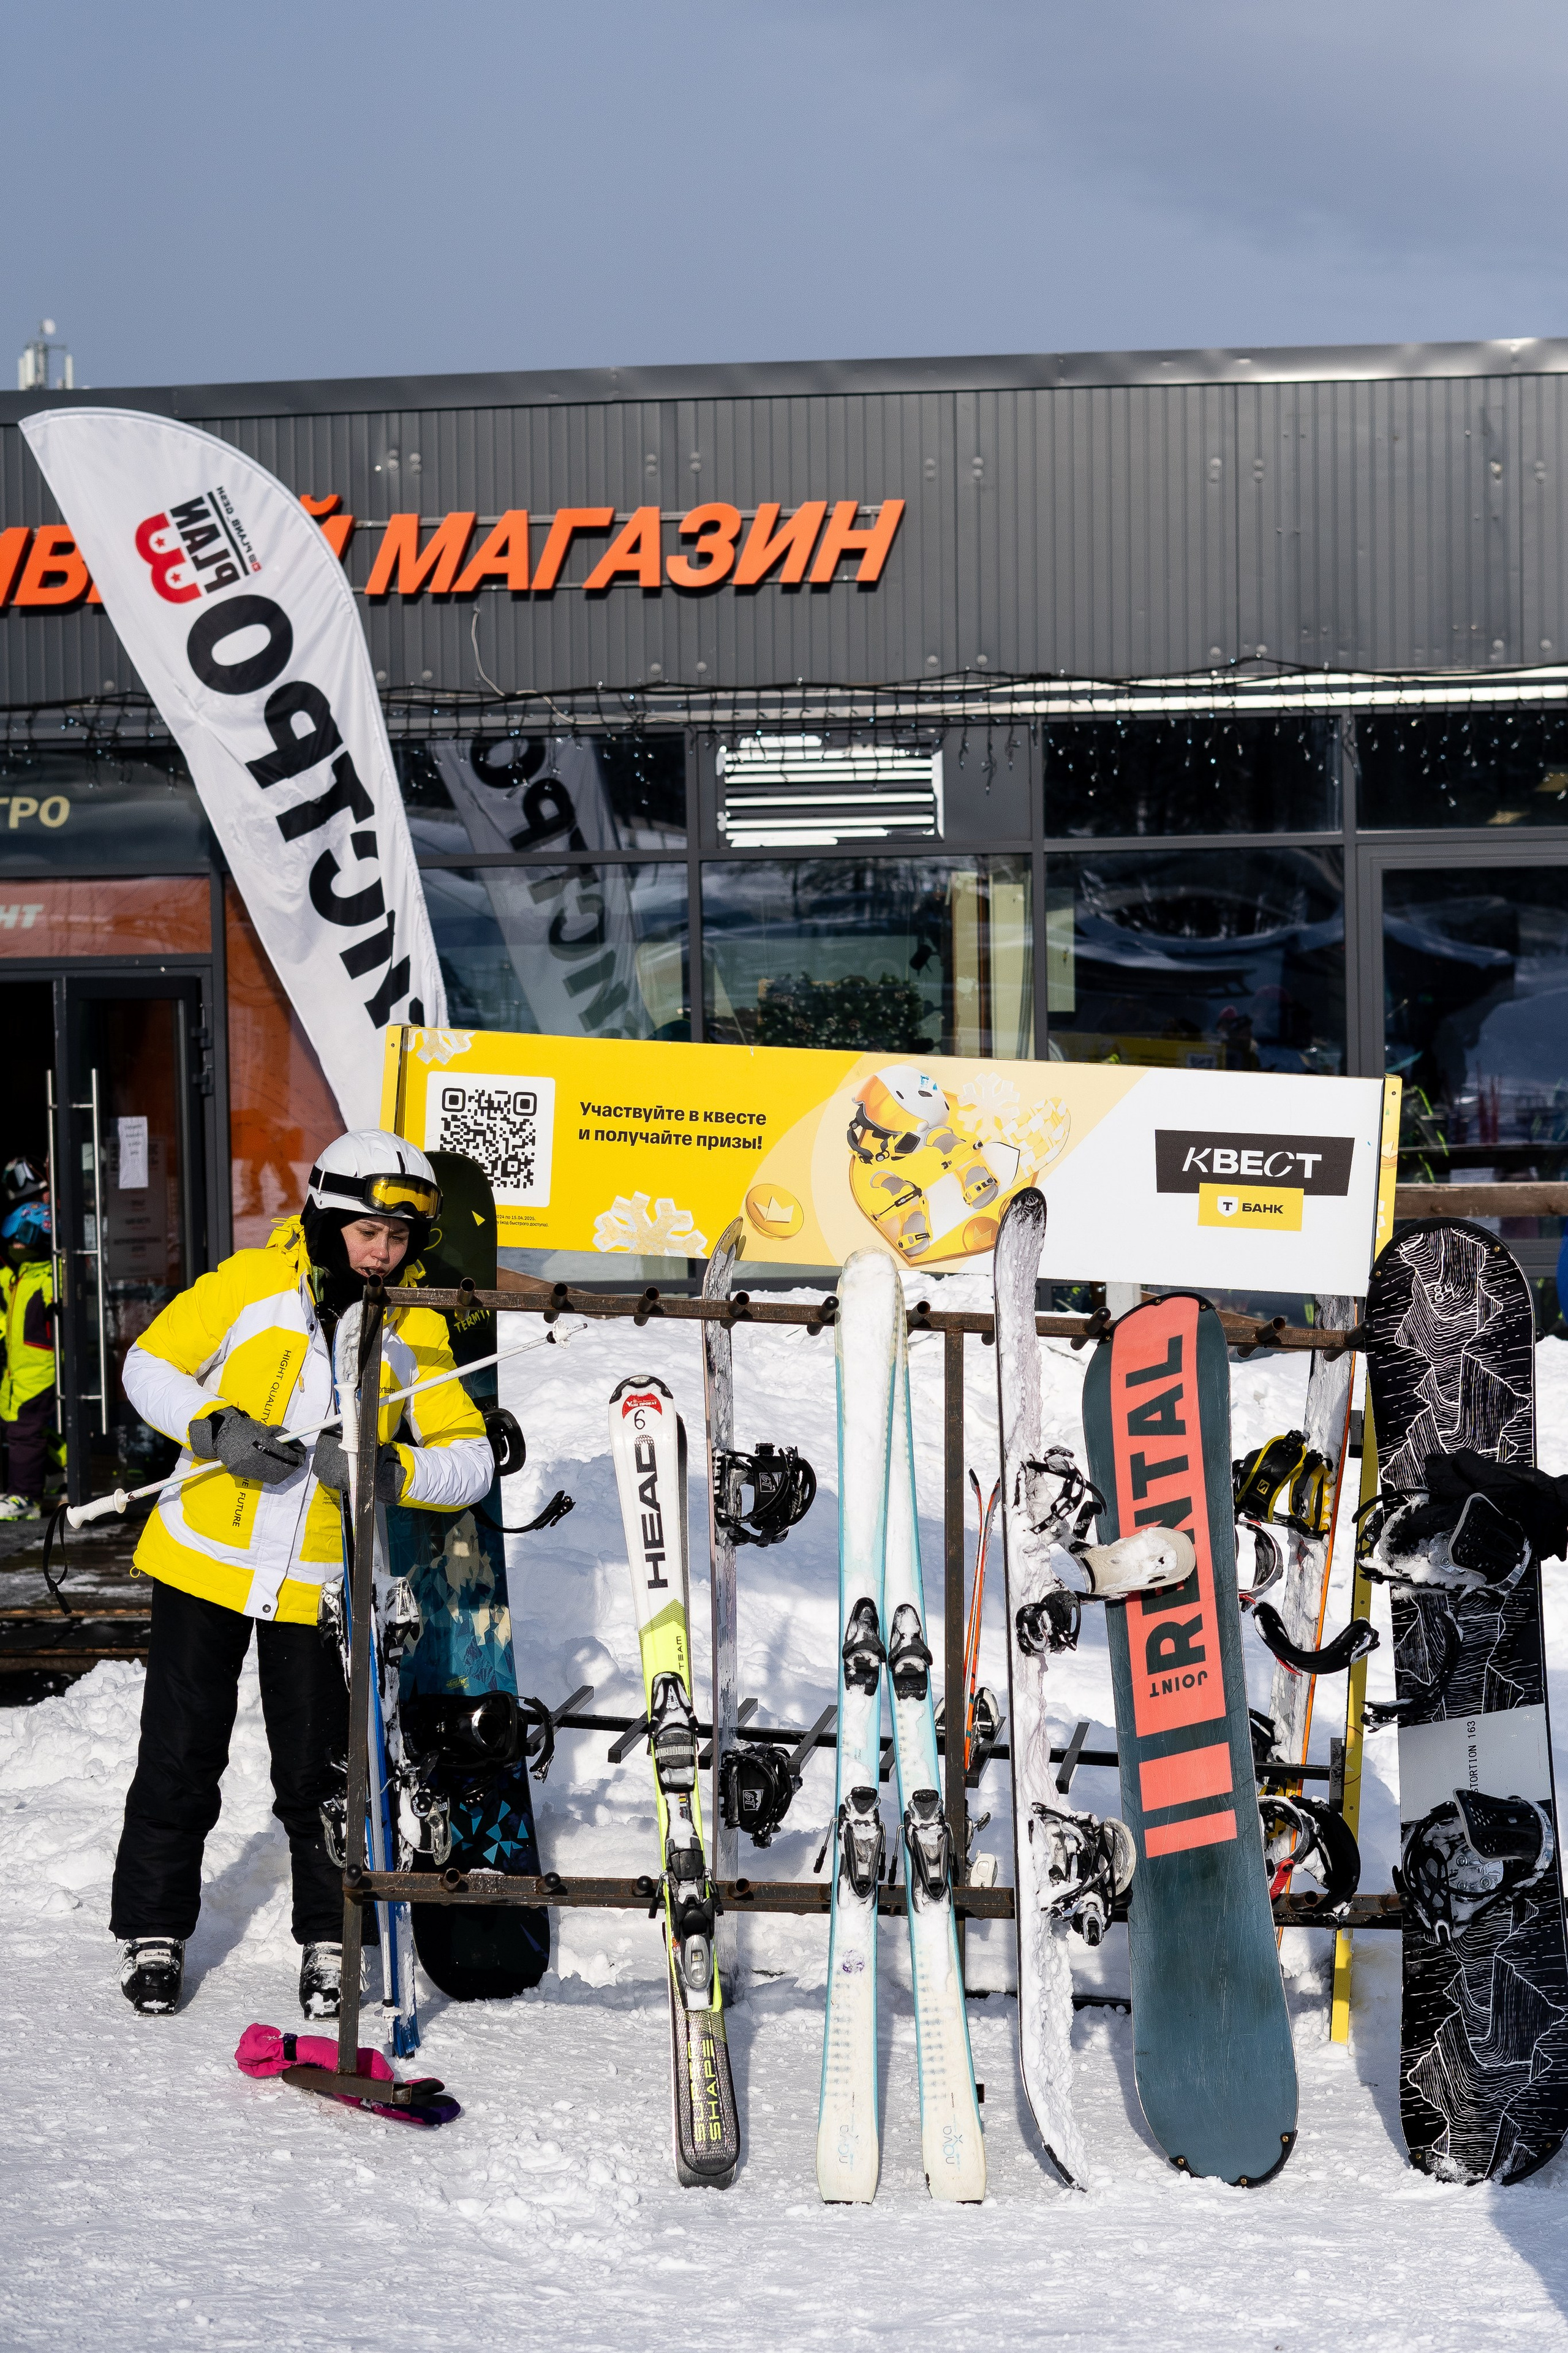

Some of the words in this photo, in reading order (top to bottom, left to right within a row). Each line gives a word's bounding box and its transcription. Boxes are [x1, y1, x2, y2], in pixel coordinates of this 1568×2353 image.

[364, 499, 905, 595] МАГАЗИН
[579, 1101, 685, 1122] Участвуйте
[689, 1110, 699, 1122] в
[703, 1111, 767, 1125] квесте
[578, 1128, 590, 1140] и
[594, 1129, 692, 1146] получайте
[696, 1135, 763, 1150] призы!
[1182, 1147, 1322, 1179] КВЕСТ
[1242, 1203, 1284, 1215] БАНК
[276, 1350, 292, 1380] HIGHT
[634, 1409, 646, 1430] 6
[232, 1491, 246, 1529] FUTURE
[634, 1434, 668, 1590] HEAD
[1149, 1670, 1208, 1698] JOINT
[1467, 1720, 1476, 1739] 163
[703, 2039, 722, 2141] SHAPE
